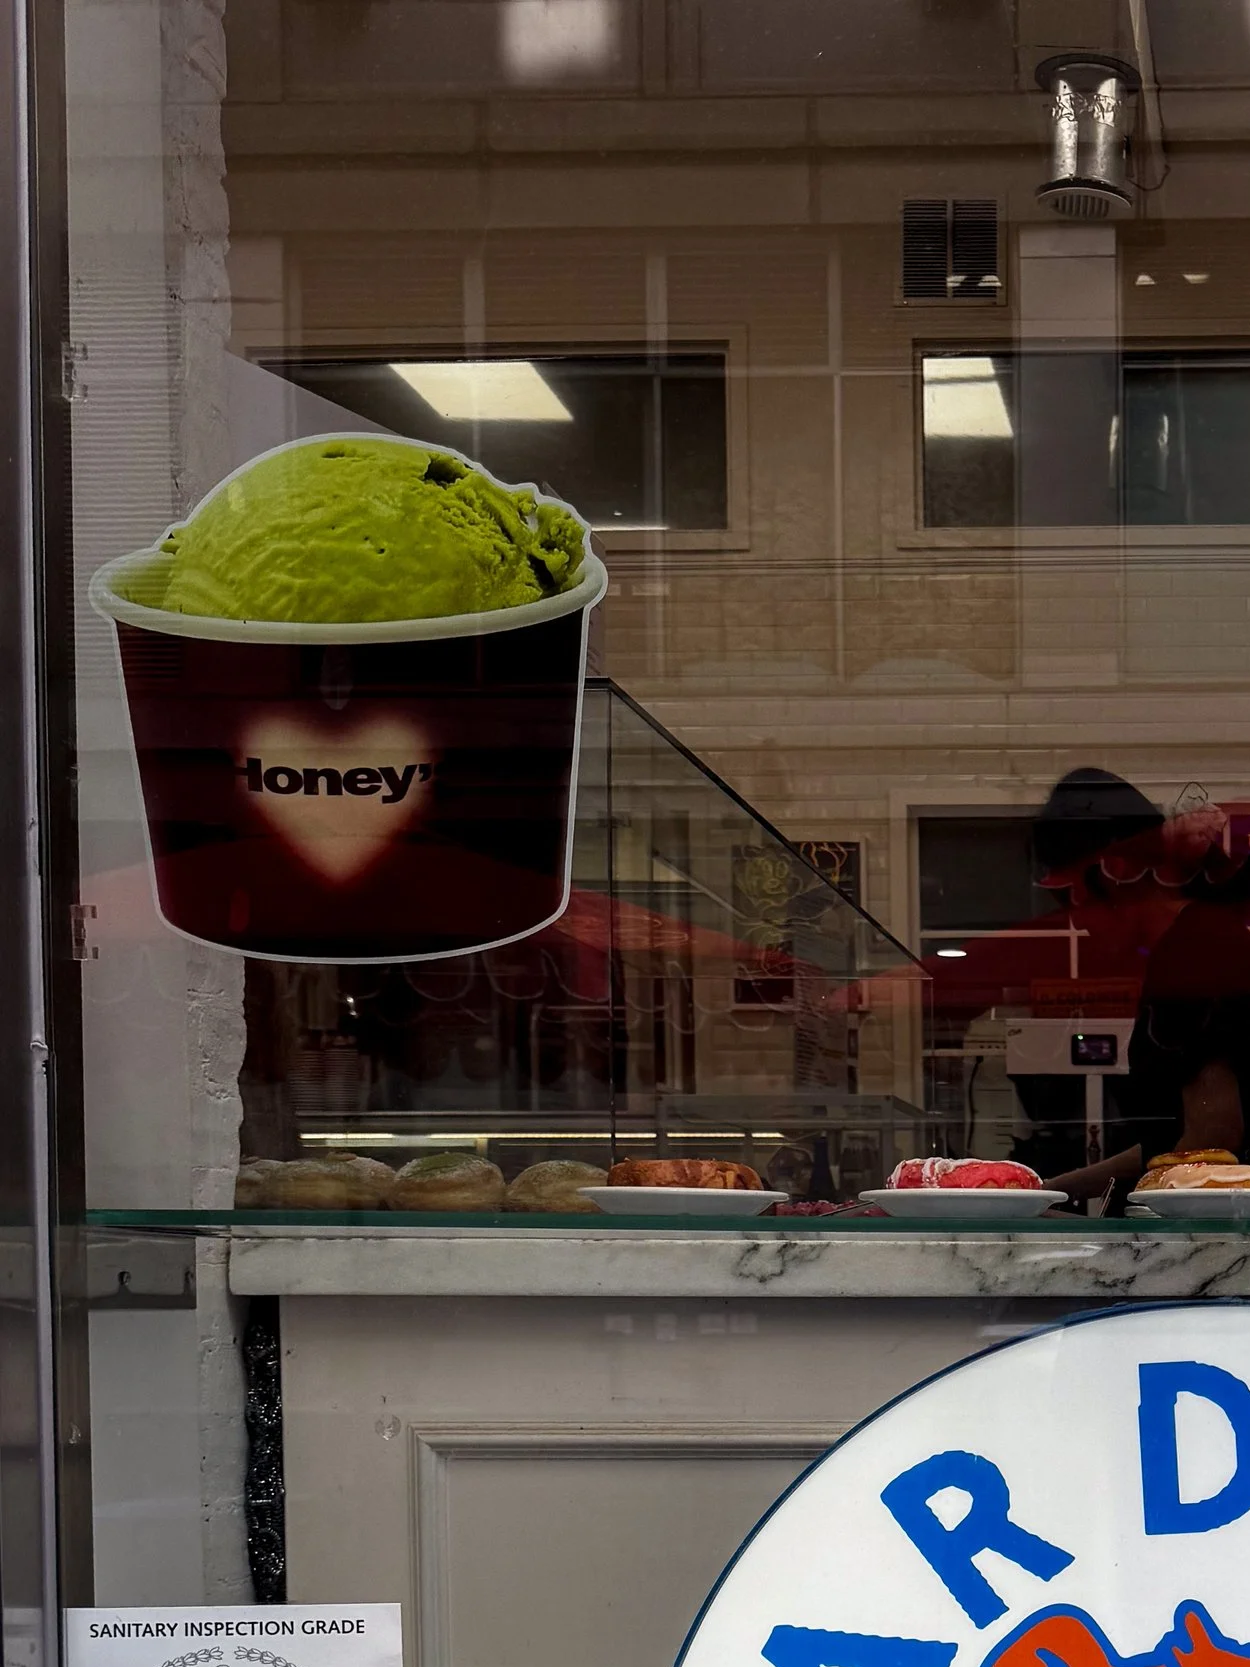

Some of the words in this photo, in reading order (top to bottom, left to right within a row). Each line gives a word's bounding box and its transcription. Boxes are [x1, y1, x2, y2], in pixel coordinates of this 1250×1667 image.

[89, 1622, 179, 1638] SANITARY
[184, 1620, 295, 1637] INSPECTION
[301, 1619, 365, 1635] GRADE
